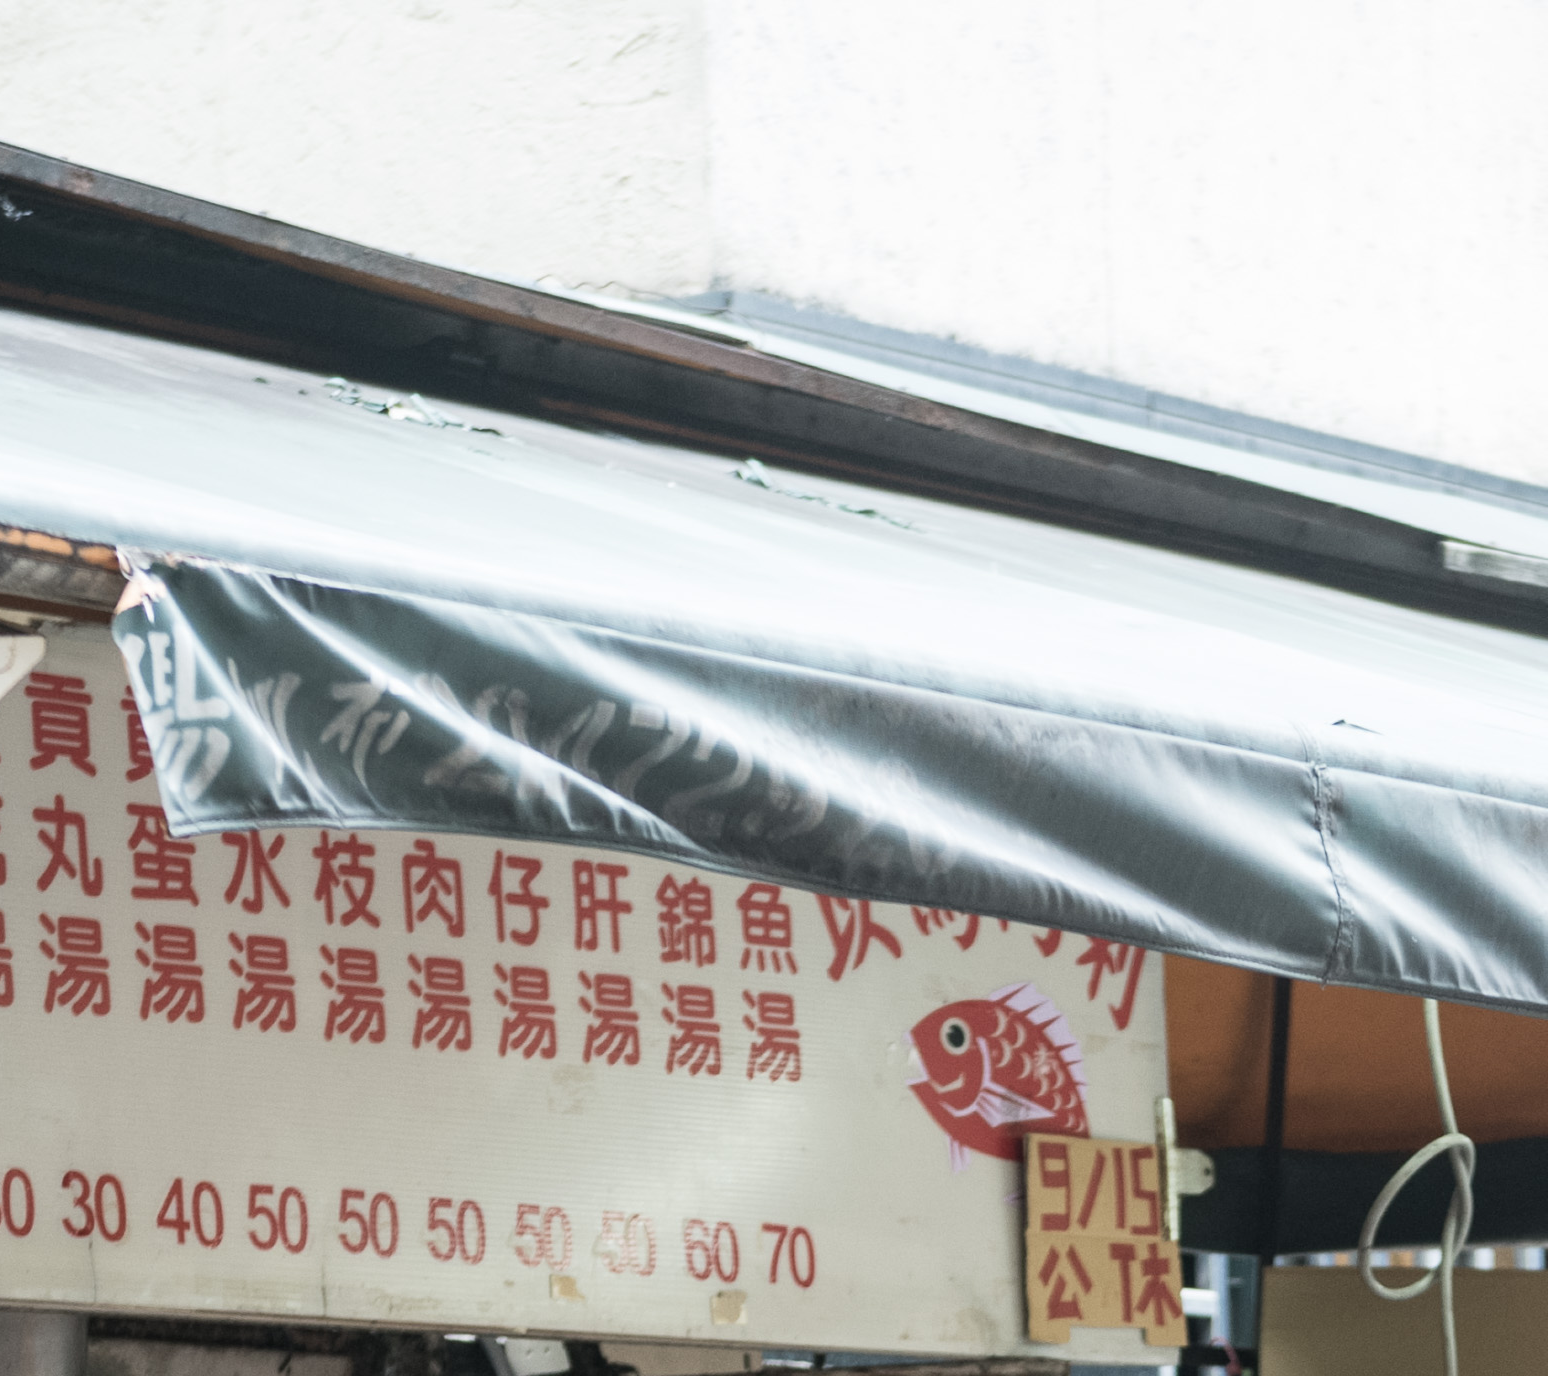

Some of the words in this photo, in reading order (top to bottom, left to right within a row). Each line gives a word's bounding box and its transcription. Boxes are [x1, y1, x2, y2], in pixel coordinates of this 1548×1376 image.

[24, 671, 111, 1017] 貢丸湯
[61, 1170, 128, 1243] 30
[156, 1177, 224, 1250] 40
[248, 1184, 308, 1255] 50
[338, 1189, 398, 1259] 50
[427, 1197, 486, 1266] 50
[516, 1204, 573, 1271] 50
[601, 1210, 657, 1277] 50
[684, 1218, 740, 1283] 60
[761, 1223, 816, 1289] 70
[1038, 1141, 1161, 1236] 9/15
[1038, 1243, 1182, 1326] 公休
